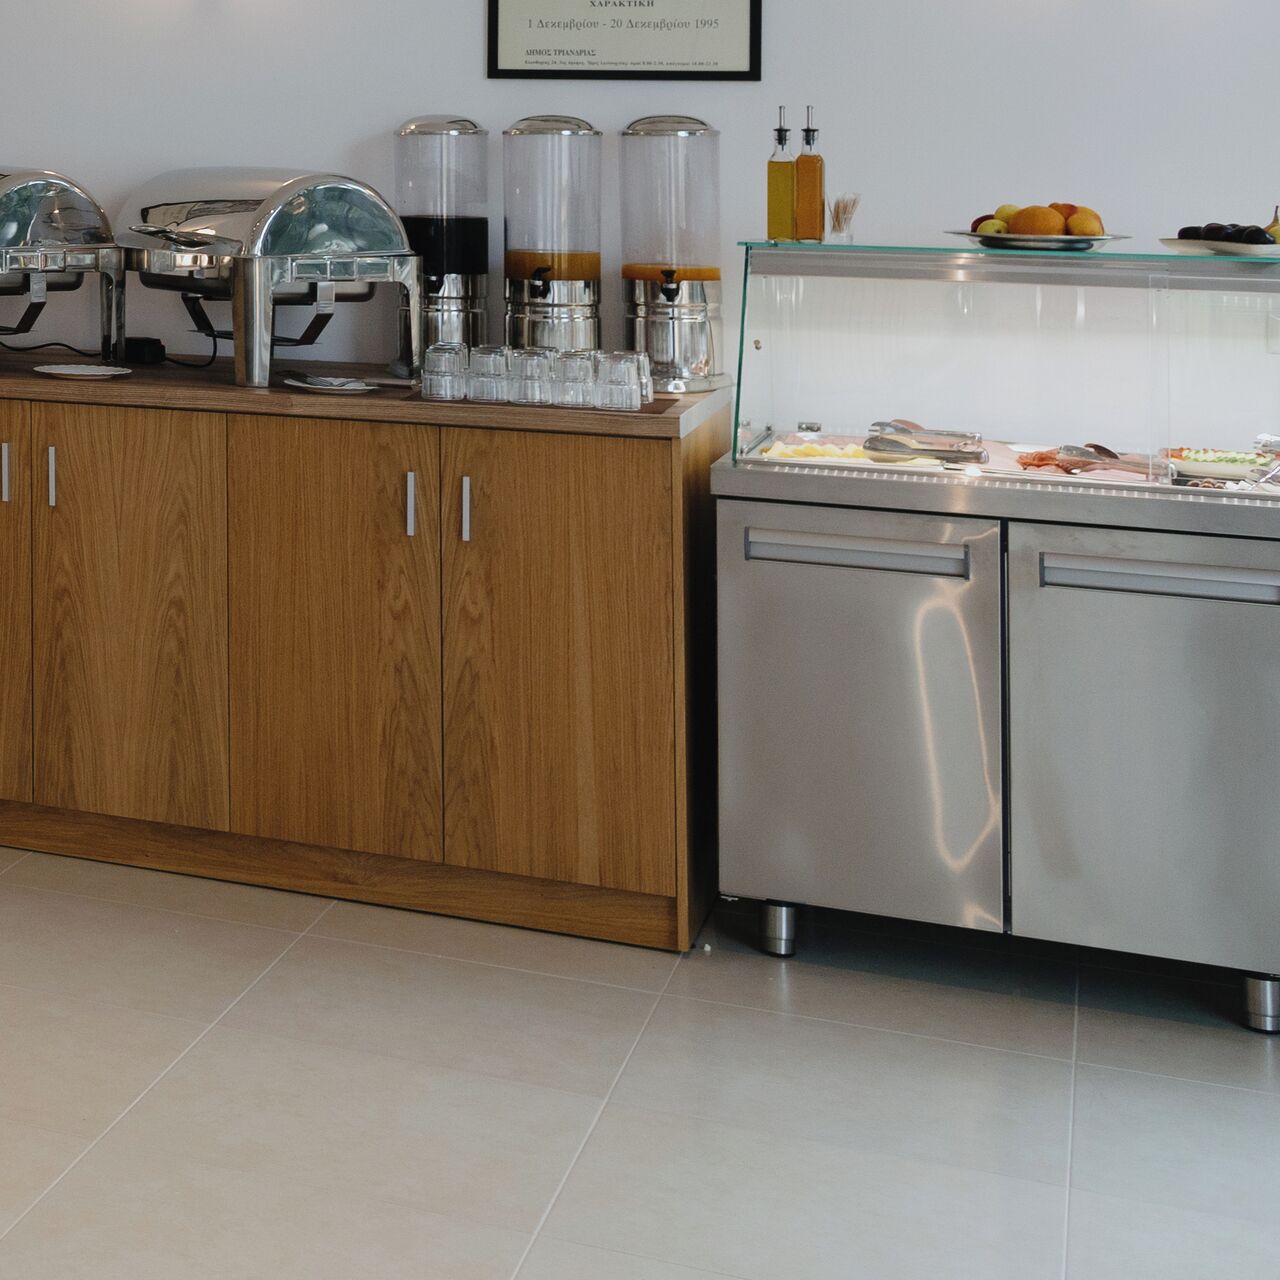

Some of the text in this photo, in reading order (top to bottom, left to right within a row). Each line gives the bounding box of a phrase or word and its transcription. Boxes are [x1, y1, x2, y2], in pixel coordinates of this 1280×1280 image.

[590, 0, 654, 8] ΧΑΡΑΚΤΙΚΗ
[610, 19, 622, 28] 20
[695, 19, 719, 28] 1995
